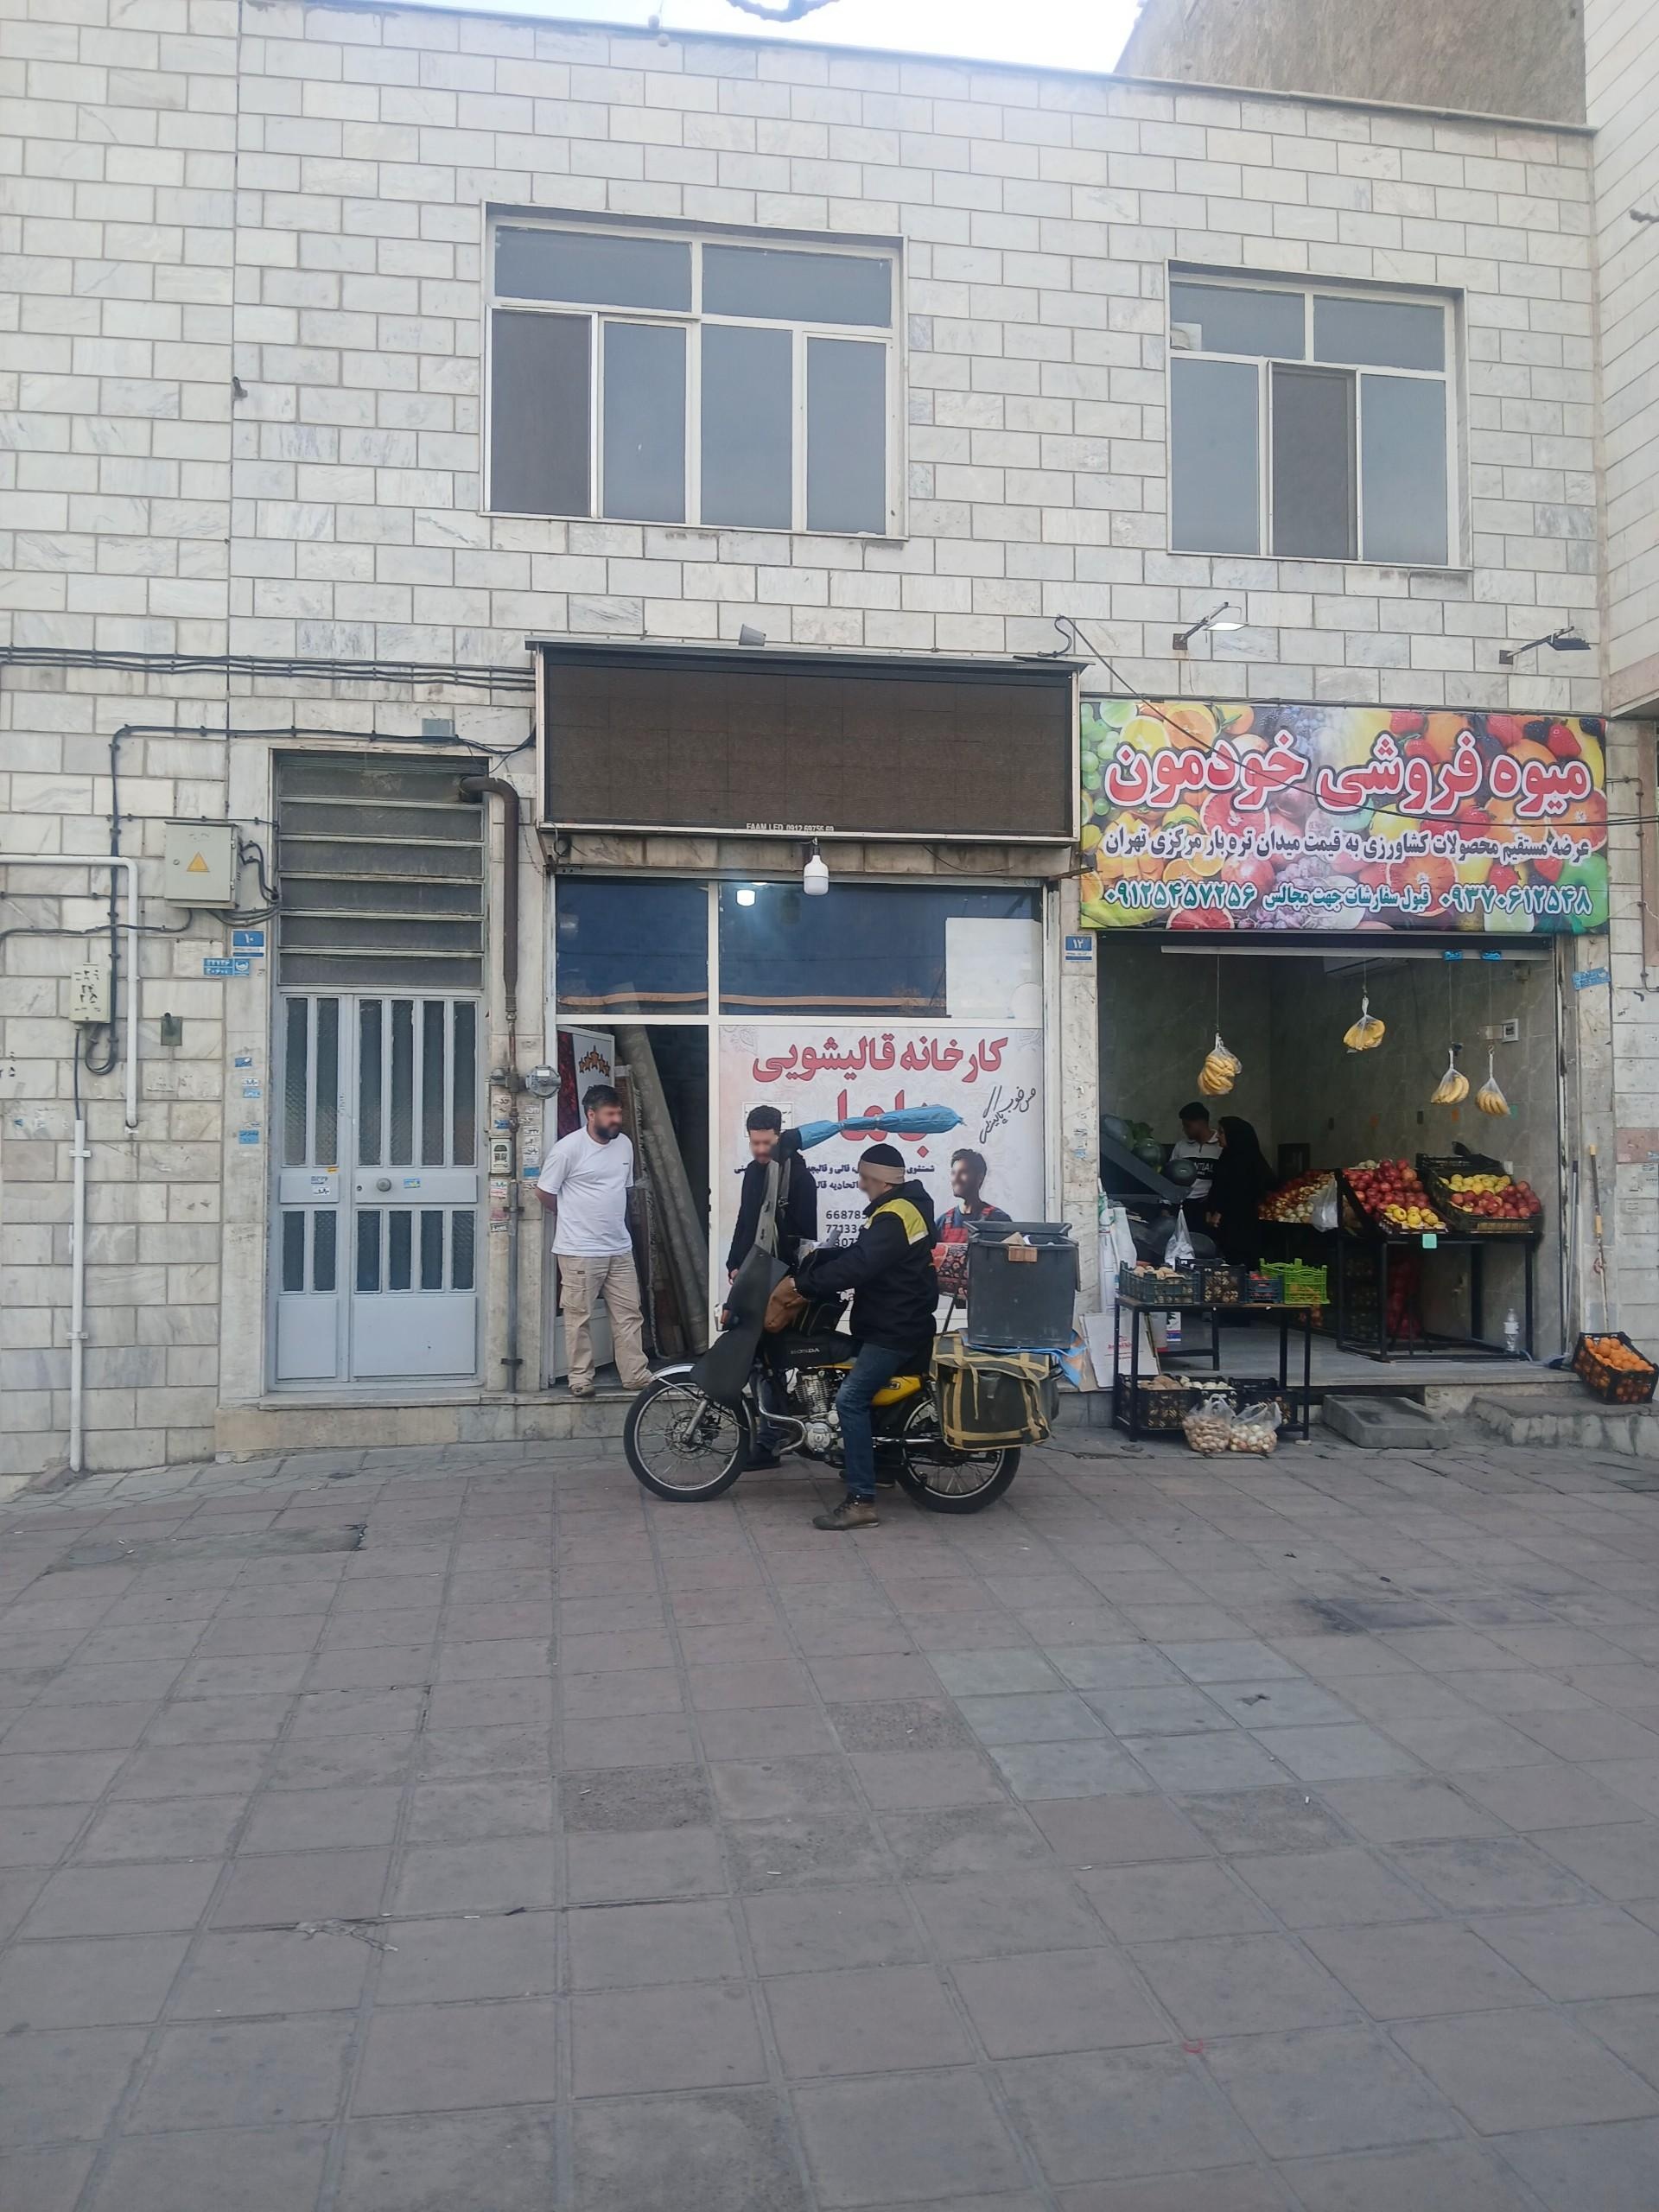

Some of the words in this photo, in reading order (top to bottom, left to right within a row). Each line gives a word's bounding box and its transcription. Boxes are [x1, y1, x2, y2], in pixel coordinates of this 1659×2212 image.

[1108, 733, 1306, 805] خودمون
[1319, 734, 1480, 811] فروشی
[1492, 758, 1588, 812] میوه
[1106, 827, 1147, 855] تهران
[1150, 829, 1201, 856] مرکزی
[1256, 830, 1300, 857] میدان
[1305, 830, 1340, 857] قیمت
[1345, 838, 1359, 857] به
[1363, 833, 1428, 860] کشاورزی
[1433, 834, 1498, 861] محصولات
[1502, 836, 1548, 862] مستقیم
[1554, 838, 1589, 863] عرضه
[1106, 881, 1255, 908] ۰۹۱۲۵۴۵۷۲۵۶
[1265, 884, 1309, 908] مجالس
[1312, 887, 1341, 909] جهت
[1345, 885, 1399, 910] سفارشات
[1402, 885, 1430, 909] قبول
[753, 1033, 896, 1083] قالیشویی
[900, 1036, 1008, 1083] کارخانه
[807, 1164, 828, 1174] قالیچ
[826, 1210, 868, 1220] 668785
